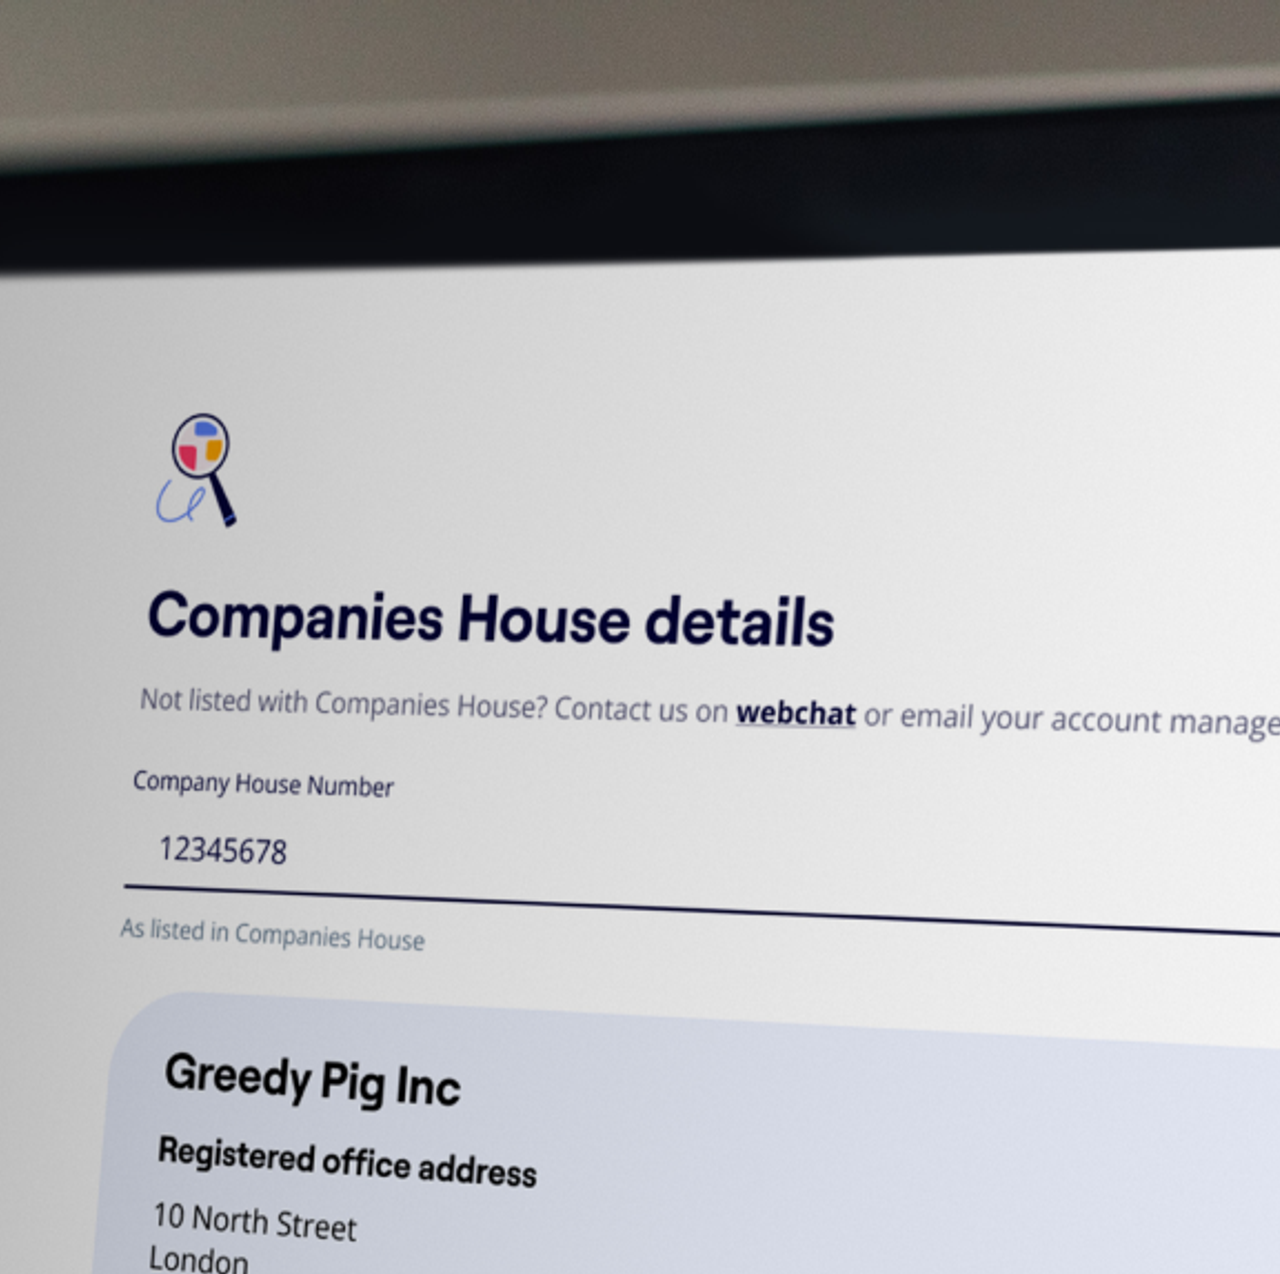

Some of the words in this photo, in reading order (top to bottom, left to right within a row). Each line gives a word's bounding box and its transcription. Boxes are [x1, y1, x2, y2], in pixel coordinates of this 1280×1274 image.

[148, 588, 444, 653] Companies
[458, 592, 631, 645] House
[644, 593, 835, 648] details
[140, 687, 183, 711] Not
[189, 687, 251, 713] listed
[258, 689, 308, 715] with
[315, 689, 450, 722] Companies
[457, 694, 548, 720] House?
[555, 695, 651, 722] Contact
[659, 703, 688, 723] us
[695, 703, 728, 723] on
[736, 698, 857, 728] webchat
[864, 707, 893, 728] or
[901, 704, 973, 728] email
[981, 710, 1043, 737] your
[1051, 711, 1160, 733] account
[133, 768, 231, 799] Company
[235, 772, 302, 796] House
[306, 774, 395, 799] Number
[160, 835, 287, 866] 12345678
[119, 916, 146, 940] As
[149, 916, 206, 942] listed
[210, 920, 230, 943] in
[235, 921, 351, 952] Companies
[357, 927, 426, 953] House
[165, 1050, 313, 1108] Greedy
[321, 1060, 386, 1113] Pig
[396, 1064, 461, 1108] Inc
[158, 1133, 316, 1174] Registered
[322, 1146, 412, 1181] office
[417, 1153, 537, 1190] address
[155, 1201, 185, 1230] 10
[192, 1204, 269, 1236] North
[276, 1209, 358, 1244] Street
